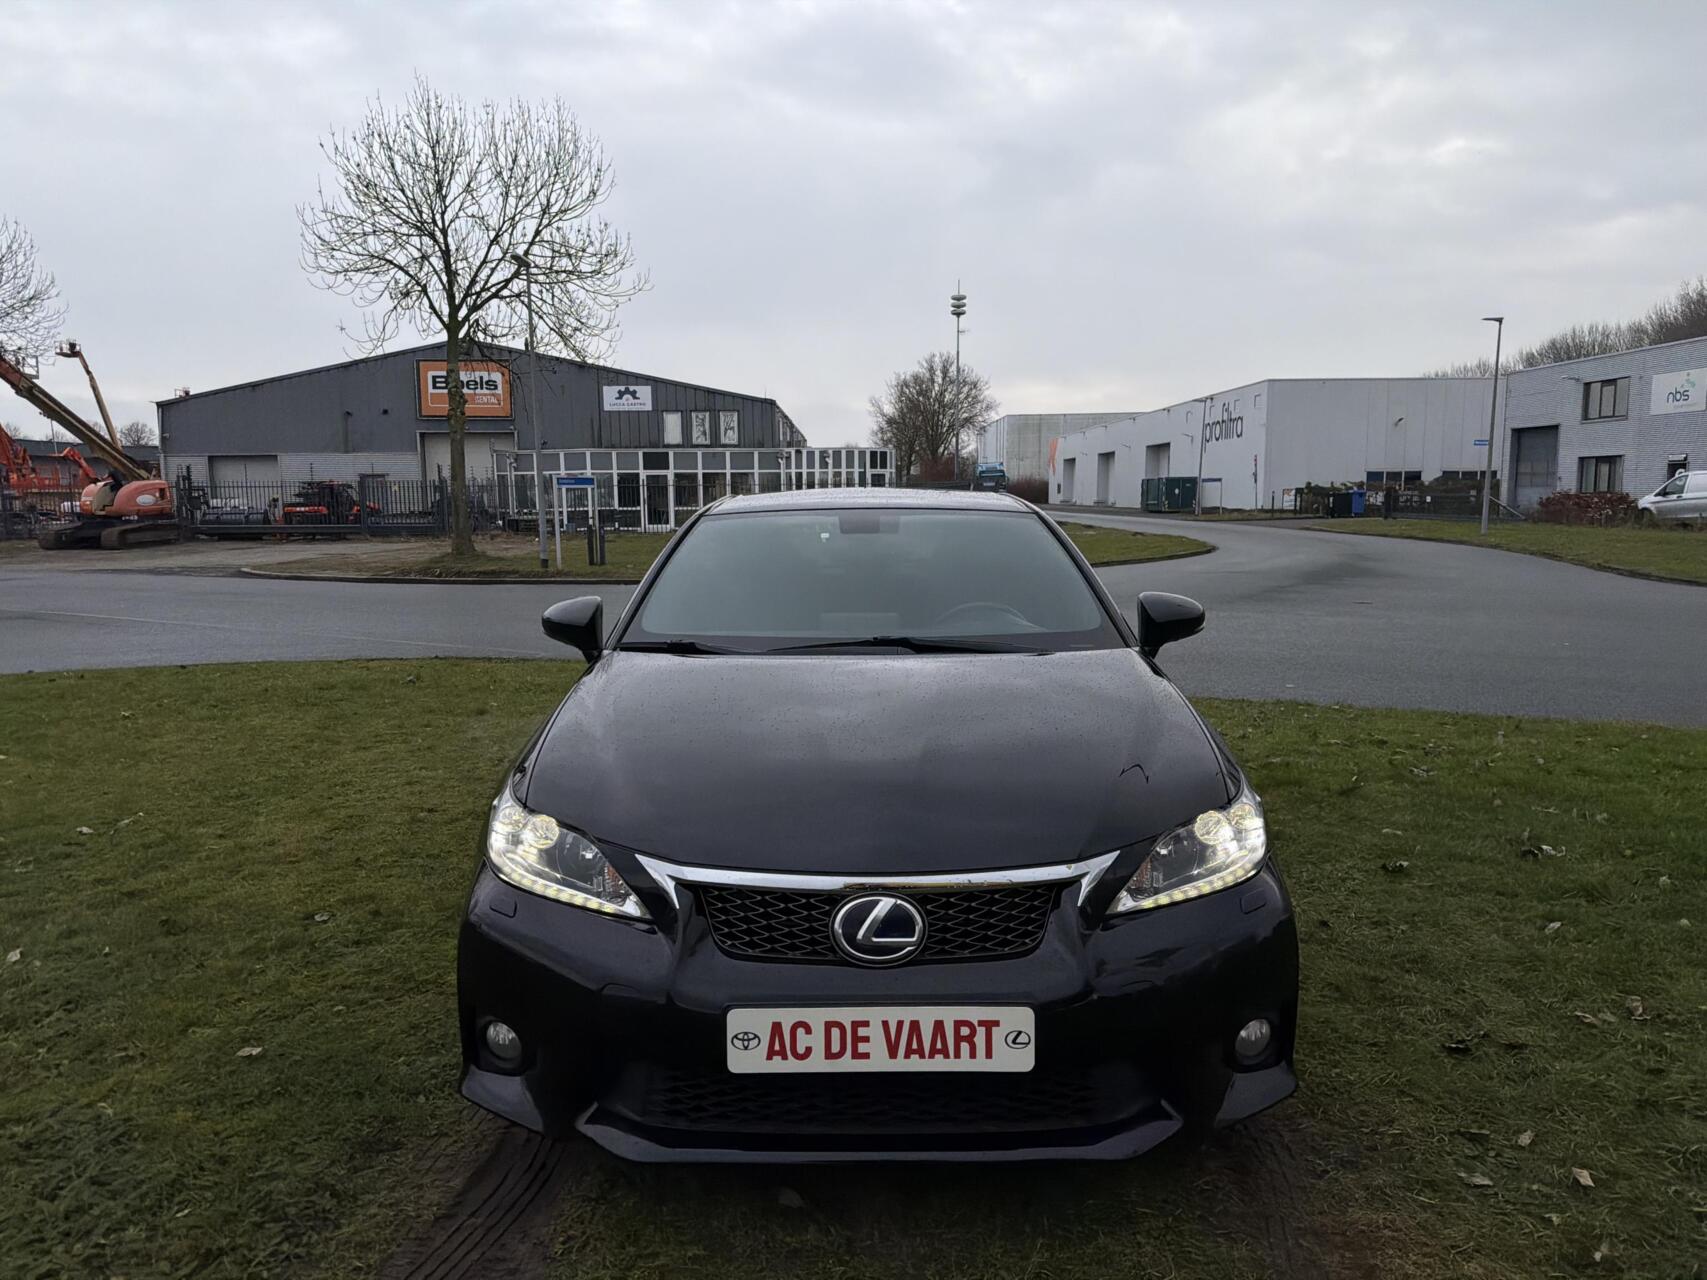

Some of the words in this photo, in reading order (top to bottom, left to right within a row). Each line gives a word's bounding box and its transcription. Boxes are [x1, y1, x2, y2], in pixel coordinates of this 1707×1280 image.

[432, 375, 498, 390] Bels
[1667, 387, 1690, 403] nbs
[1204, 402, 1243, 453] profiltra
[765, 1021, 813, 1061] AC
[824, 1020, 871, 1060] DE
[881, 1019, 1000, 1060] VAART
